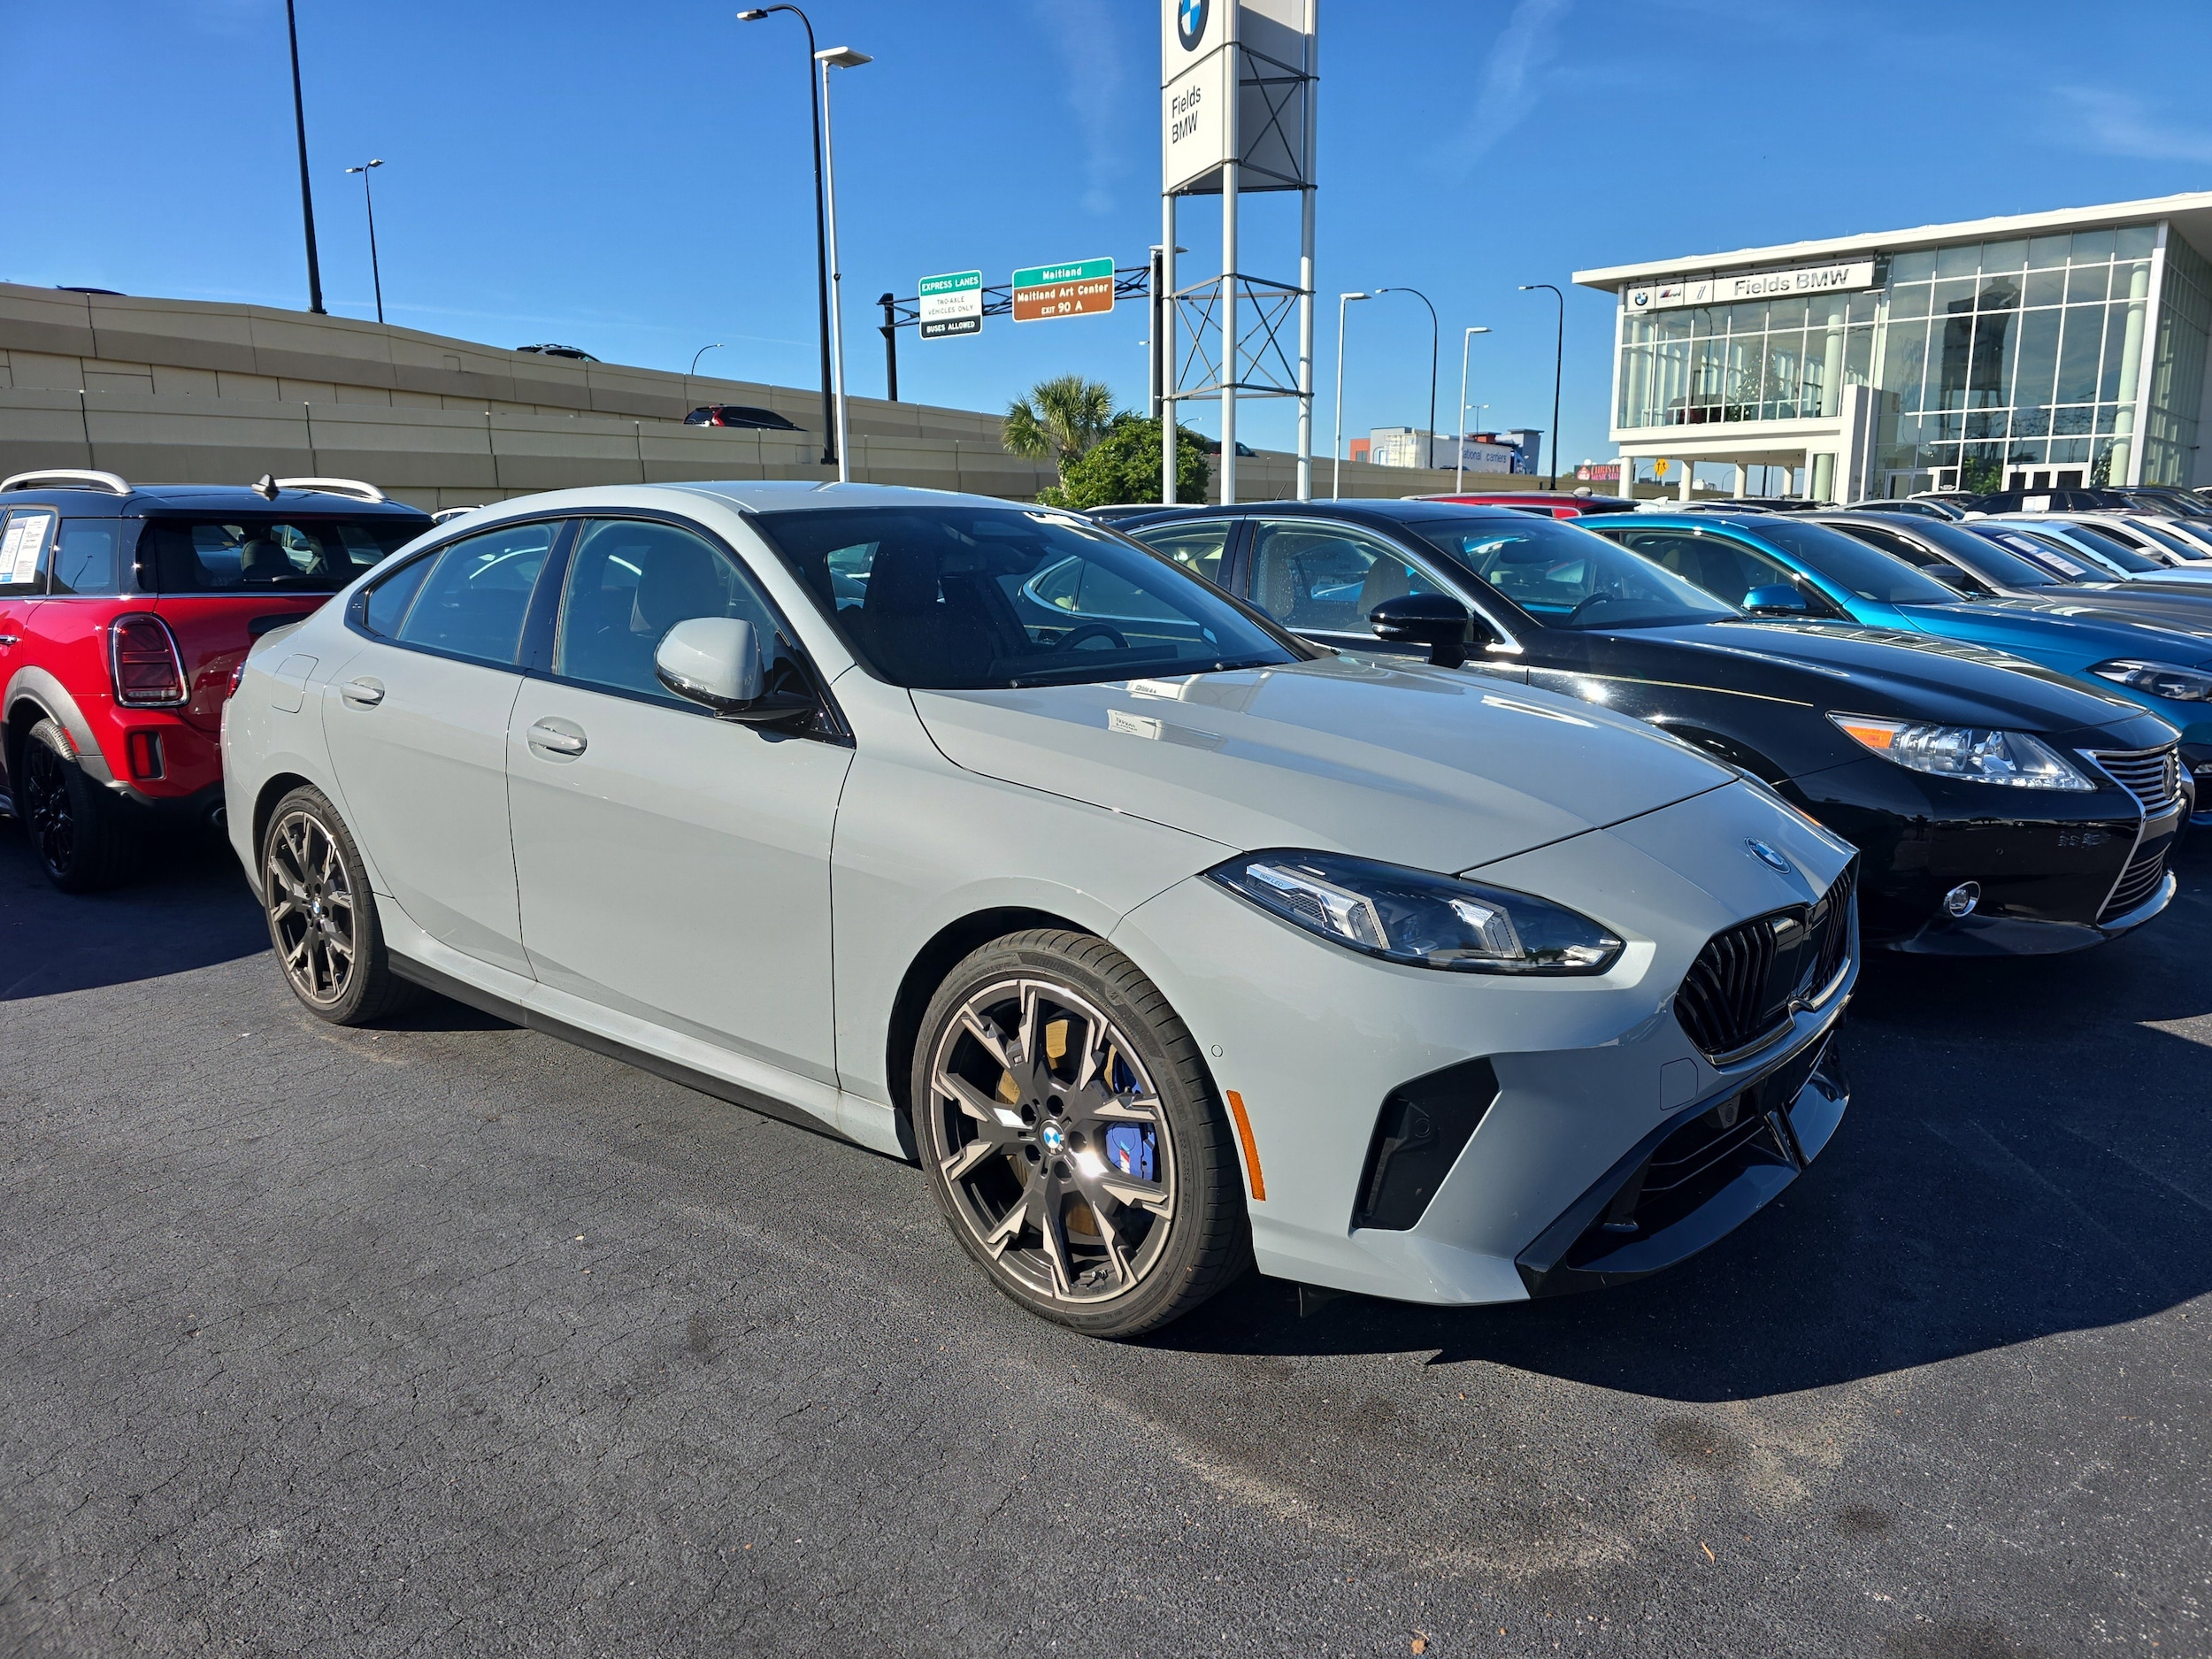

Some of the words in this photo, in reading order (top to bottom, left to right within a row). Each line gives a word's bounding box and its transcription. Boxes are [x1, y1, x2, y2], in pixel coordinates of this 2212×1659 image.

[1172, 85, 1202, 119] Fields
[1172, 110, 1198, 144] BMW
[1042, 266, 1082, 280] Maitland
[921, 280, 953, 292] EXPRESS
[955, 276, 979, 288] LANES
[1734, 276, 1790, 296] Fields
[1796, 268, 1849, 289] BMW
[1018, 288, 1056, 303] Maitland
[1059, 287, 1074, 297] Art
[1078, 283, 1109, 296] Center
[927, 306, 956, 315] VEHICLES
[1041, 305, 1056, 315] EXIT
[1057, 302, 1071, 313] 90
[1075, 300, 1083, 311] A
[926, 324, 946, 334] BUSES
[948, 320, 975, 331] ALLOWED
[1463, 449, 1481, 460] ational
[1486, 452, 1507, 464] carriers
